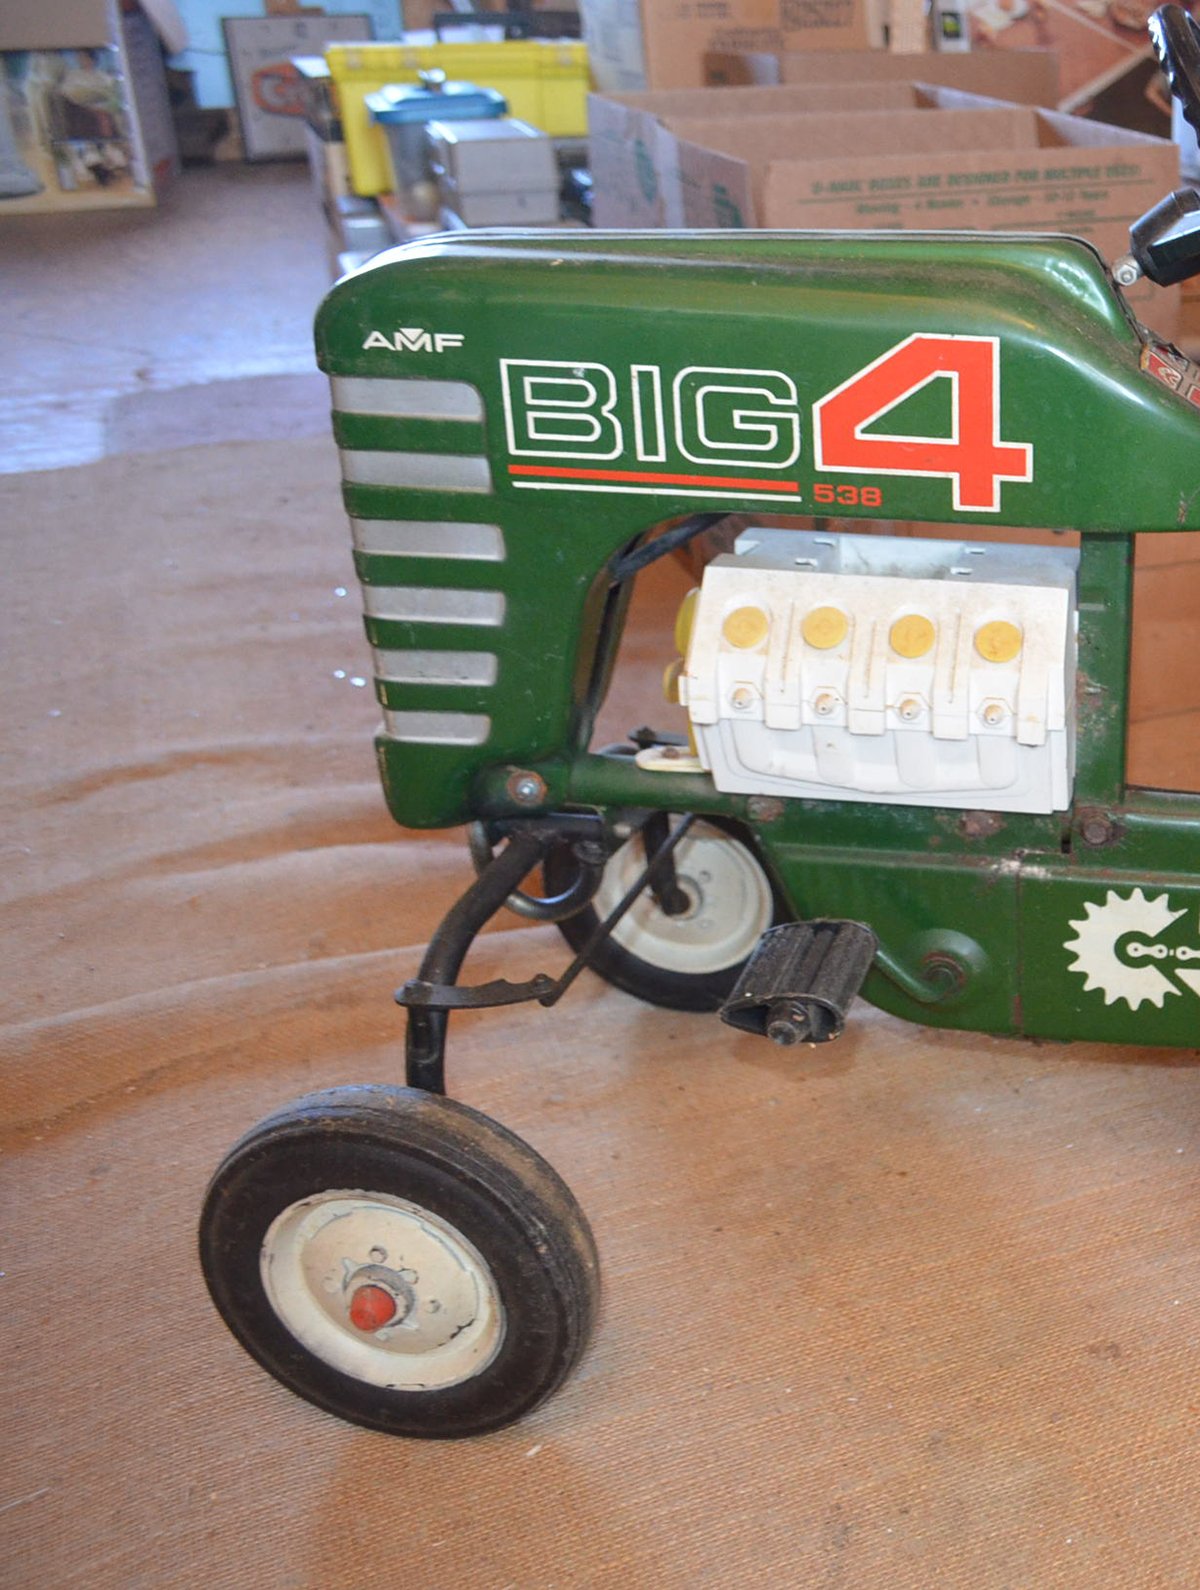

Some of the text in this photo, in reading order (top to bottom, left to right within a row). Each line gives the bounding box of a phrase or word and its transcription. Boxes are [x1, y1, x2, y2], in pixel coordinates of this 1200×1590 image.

[363, 327, 464, 354] AMF
[500, 331, 1034, 513] BIG 4
[812, 483, 882, 507] 538
